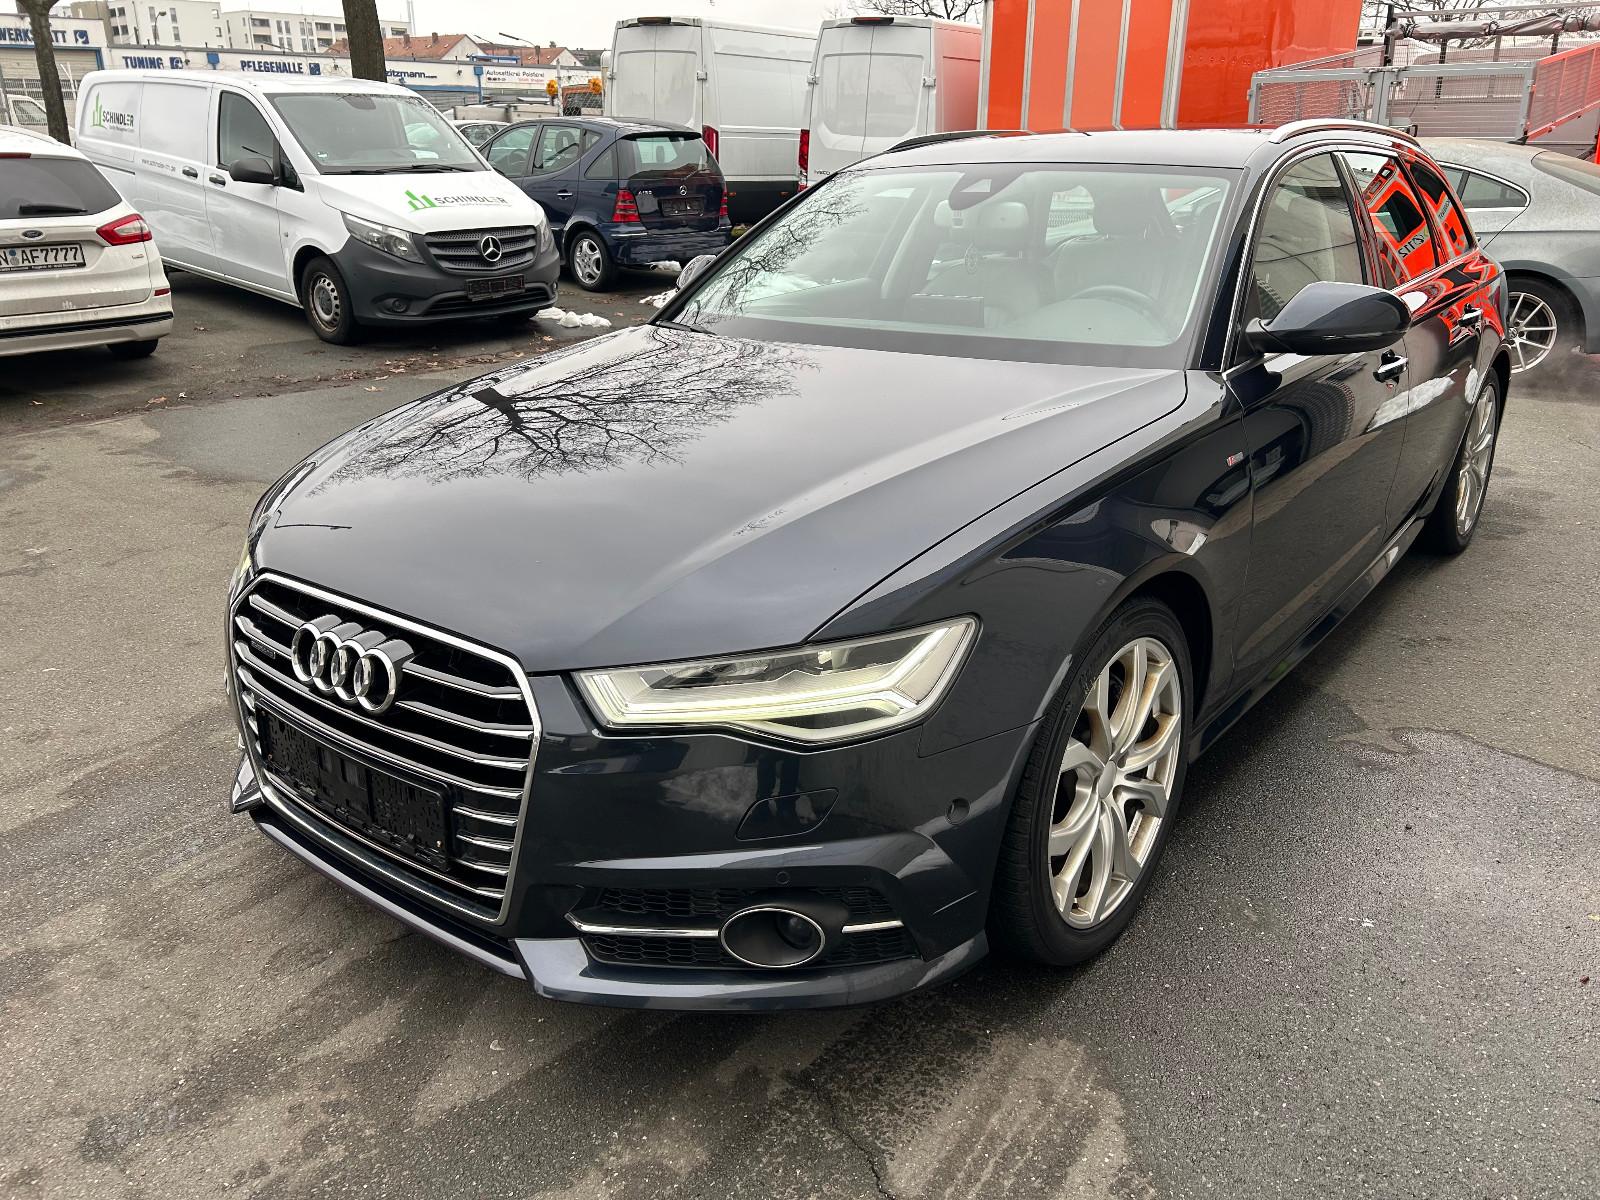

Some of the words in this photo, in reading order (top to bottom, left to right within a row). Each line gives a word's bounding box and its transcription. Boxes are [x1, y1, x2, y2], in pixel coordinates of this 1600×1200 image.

[0, 27, 66, 43] WERKTT
[122, 56, 164, 69] TUNING
[240, 60, 304, 74] PFLEGEHALLE
[103, 110, 134, 127] SCHINDLER
[434, 196, 508, 204] SCHINDLER
[21, 246, 79, 264] AF7777
